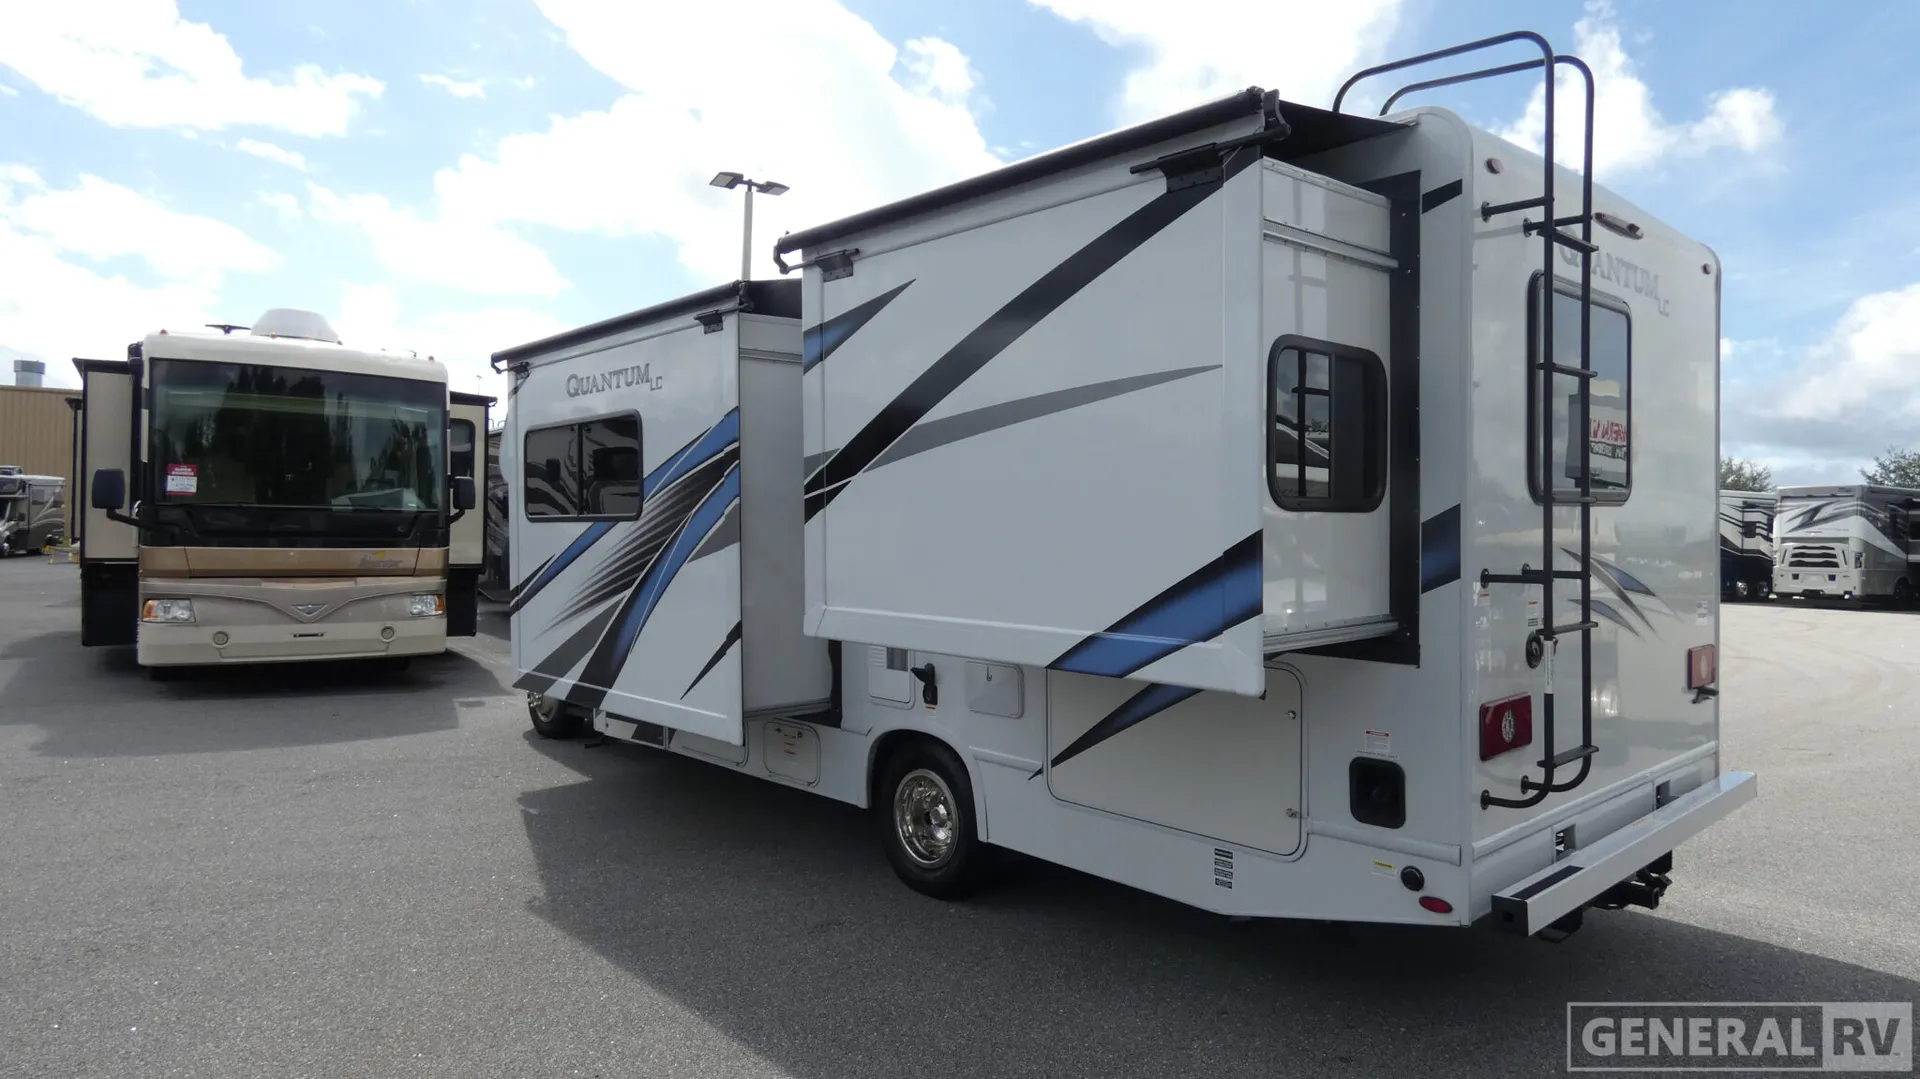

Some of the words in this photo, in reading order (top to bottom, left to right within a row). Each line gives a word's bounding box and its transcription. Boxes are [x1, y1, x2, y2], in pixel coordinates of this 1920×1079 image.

[1559, 225, 1660, 301] QANTUM
[566, 362, 650, 398] QUANTUM
[650, 375, 663, 391] LC
